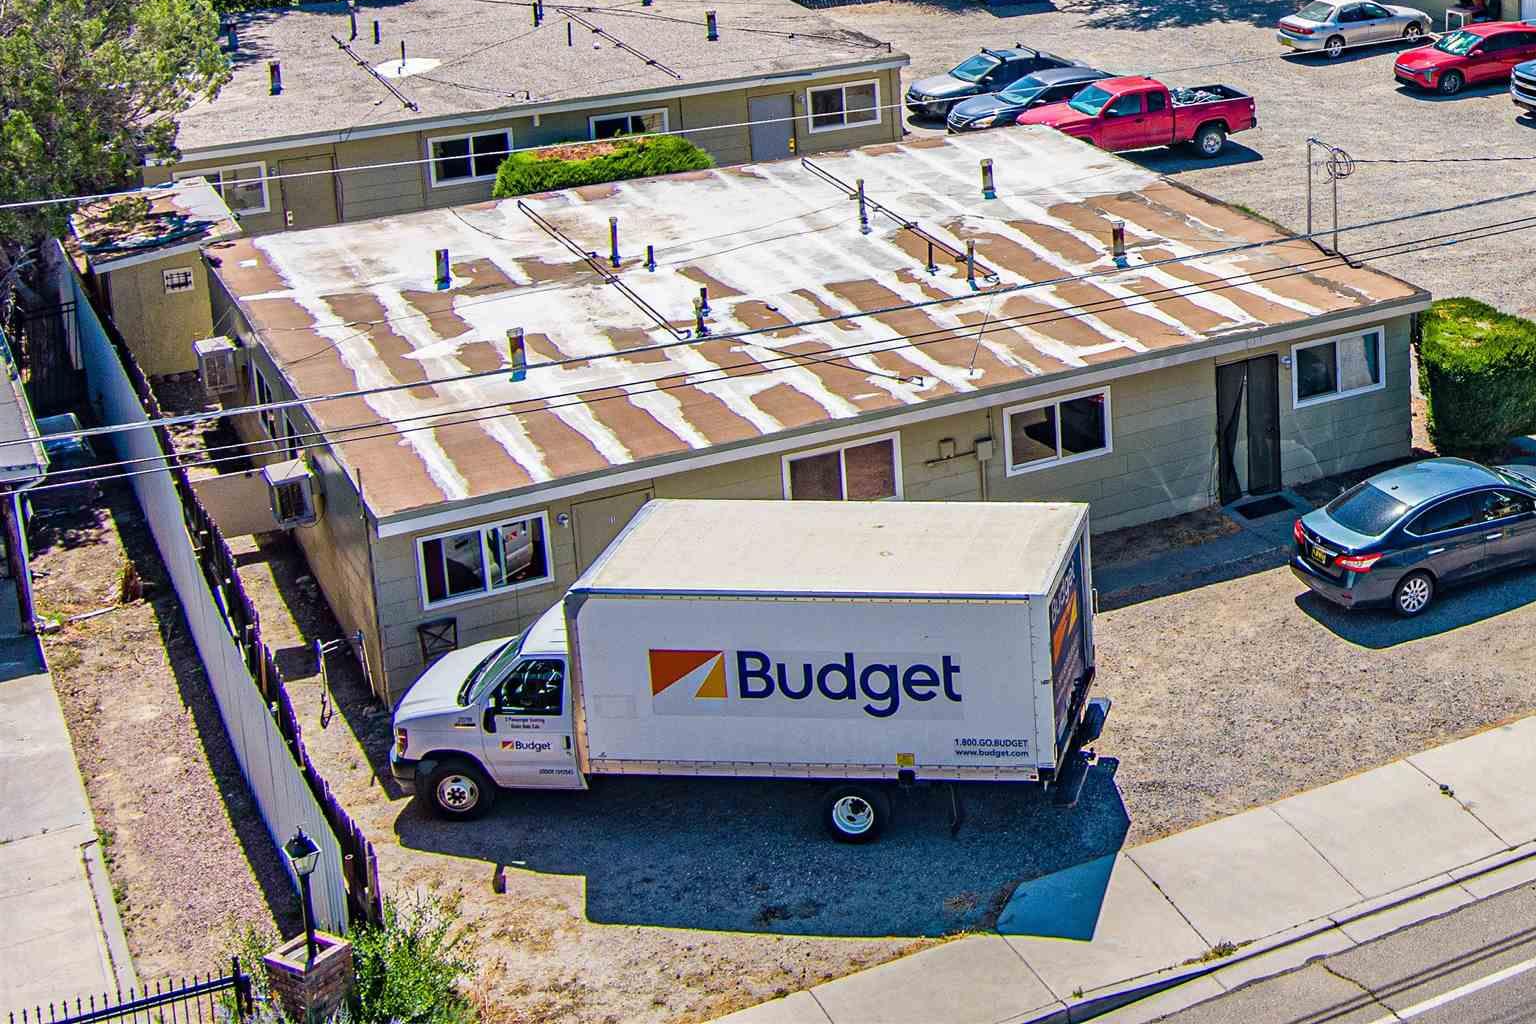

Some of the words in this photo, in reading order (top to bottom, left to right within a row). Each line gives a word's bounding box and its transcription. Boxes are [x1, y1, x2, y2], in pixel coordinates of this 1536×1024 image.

[736, 650, 962, 718] Budget
[515, 740, 552, 753] Budget
[954, 749, 1029, 758] www.budget.com
